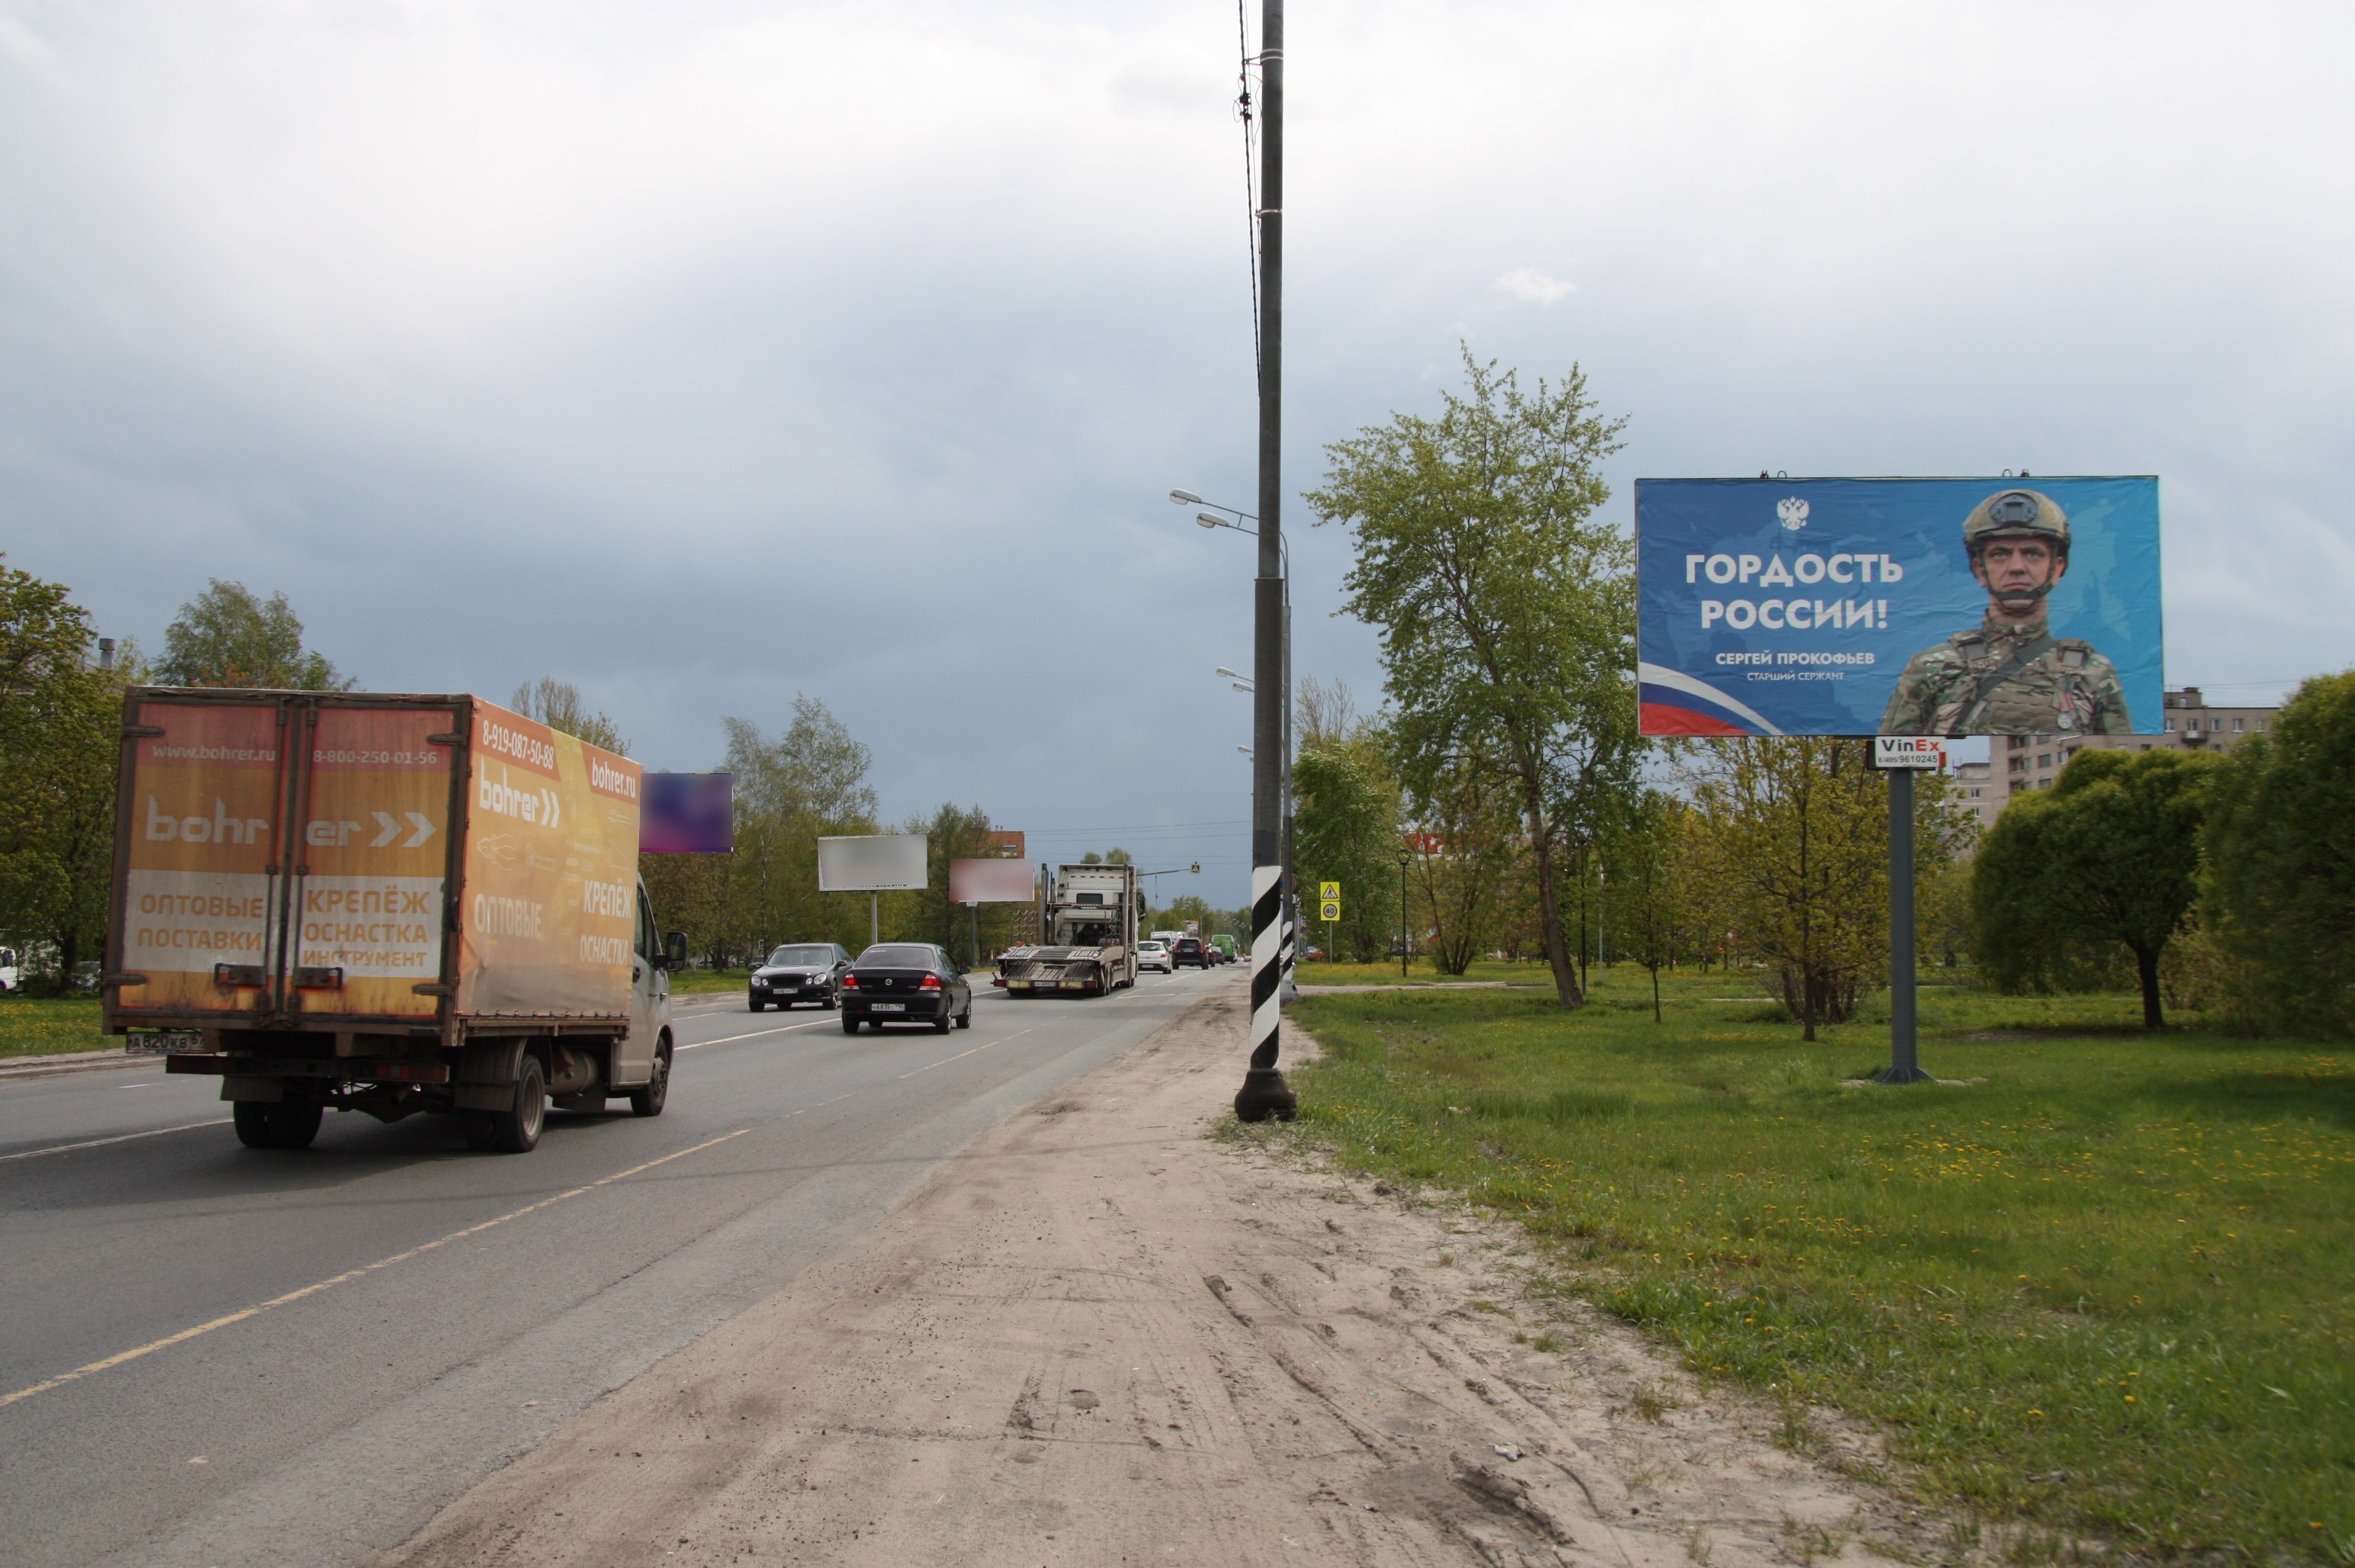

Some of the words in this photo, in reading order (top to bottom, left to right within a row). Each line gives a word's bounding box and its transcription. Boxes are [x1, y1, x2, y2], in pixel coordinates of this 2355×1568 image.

[1686, 554, 1903, 587] ГОРДОСТЬ
[1701, 599, 1888, 630] РОССИИ!
[1715, 650, 1773, 665] СЕРГЕЙ
[1777, 652, 1876, 666] ПРОКОФЬЕВ
[1746, 670, 1794, 681] СТАРШИЙ
[1798, 671, 1845, 682] СЕРЖАНТ
[153, 744, 276, 763] www.bohrer.ru
[313, 750, 438, 765] 8-800-250-01-56
[482, 720, 554, 770] 8-919-087-50-88
[1881, 738, 1941, 752] VinEx
[479, 756, 540, 823] bohrer
[592, 757, 636, 798] bohrer.ru
[140, 893, 265, 918] ОПТОВЫЕ
[306, 885, 430, 915] КРЕПЁЖ
[583, 879, 633, 918] КРЕПЁЖ
[474, 893, 543, 940] ОПТОВЫЕ
[137, 927, 262, 951] ПОСТАВКИ
[305, 922, 429, 943] ОСНАСТКА
[304, 950, 427, 968] ИНСТРУМЕНТ
[580, 934, 628, 966] ОСНАСТКА
